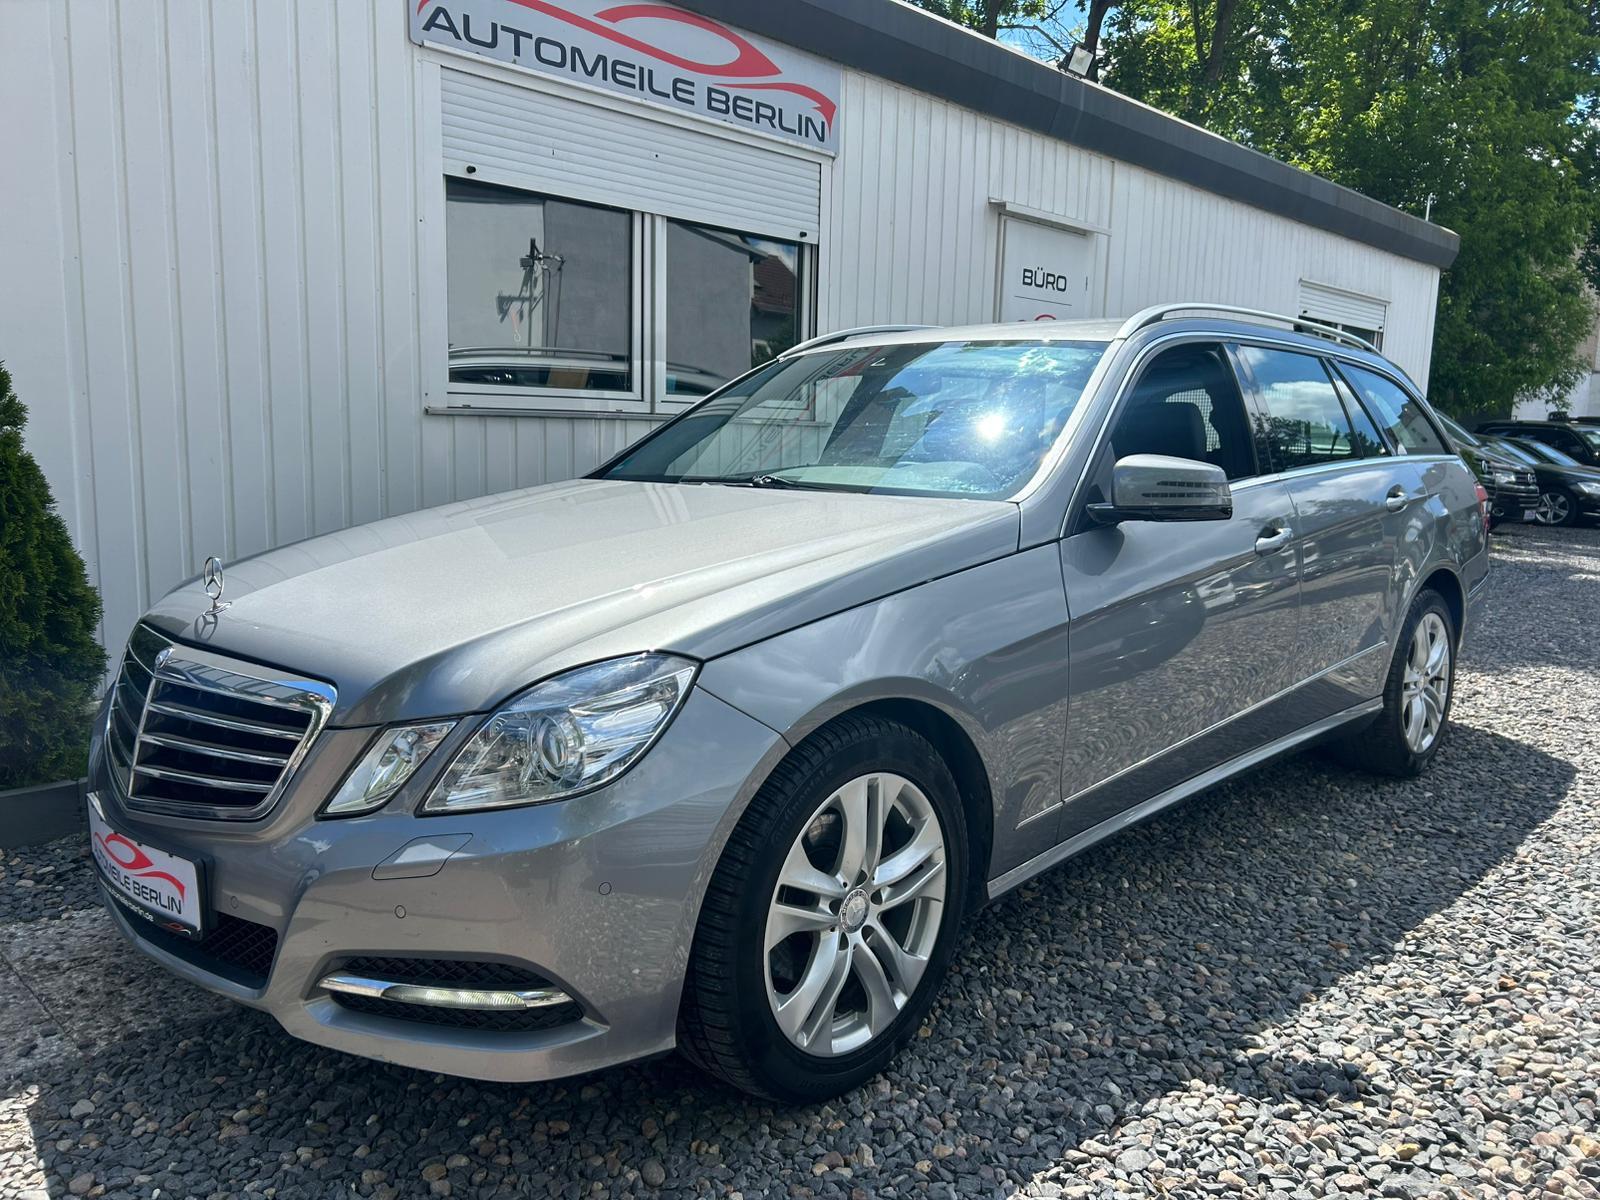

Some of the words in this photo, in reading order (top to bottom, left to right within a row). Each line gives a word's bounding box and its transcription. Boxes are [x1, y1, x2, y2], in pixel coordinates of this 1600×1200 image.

[422, 5, 695, 106] AUTOMEILE
[706, 86, 826, 143] BERLIN
[1022, 266, 1067, 292] BÜRO
[94, 846, 131, 891] OMEILE
[132, 880, 182, 914] BERLIN
